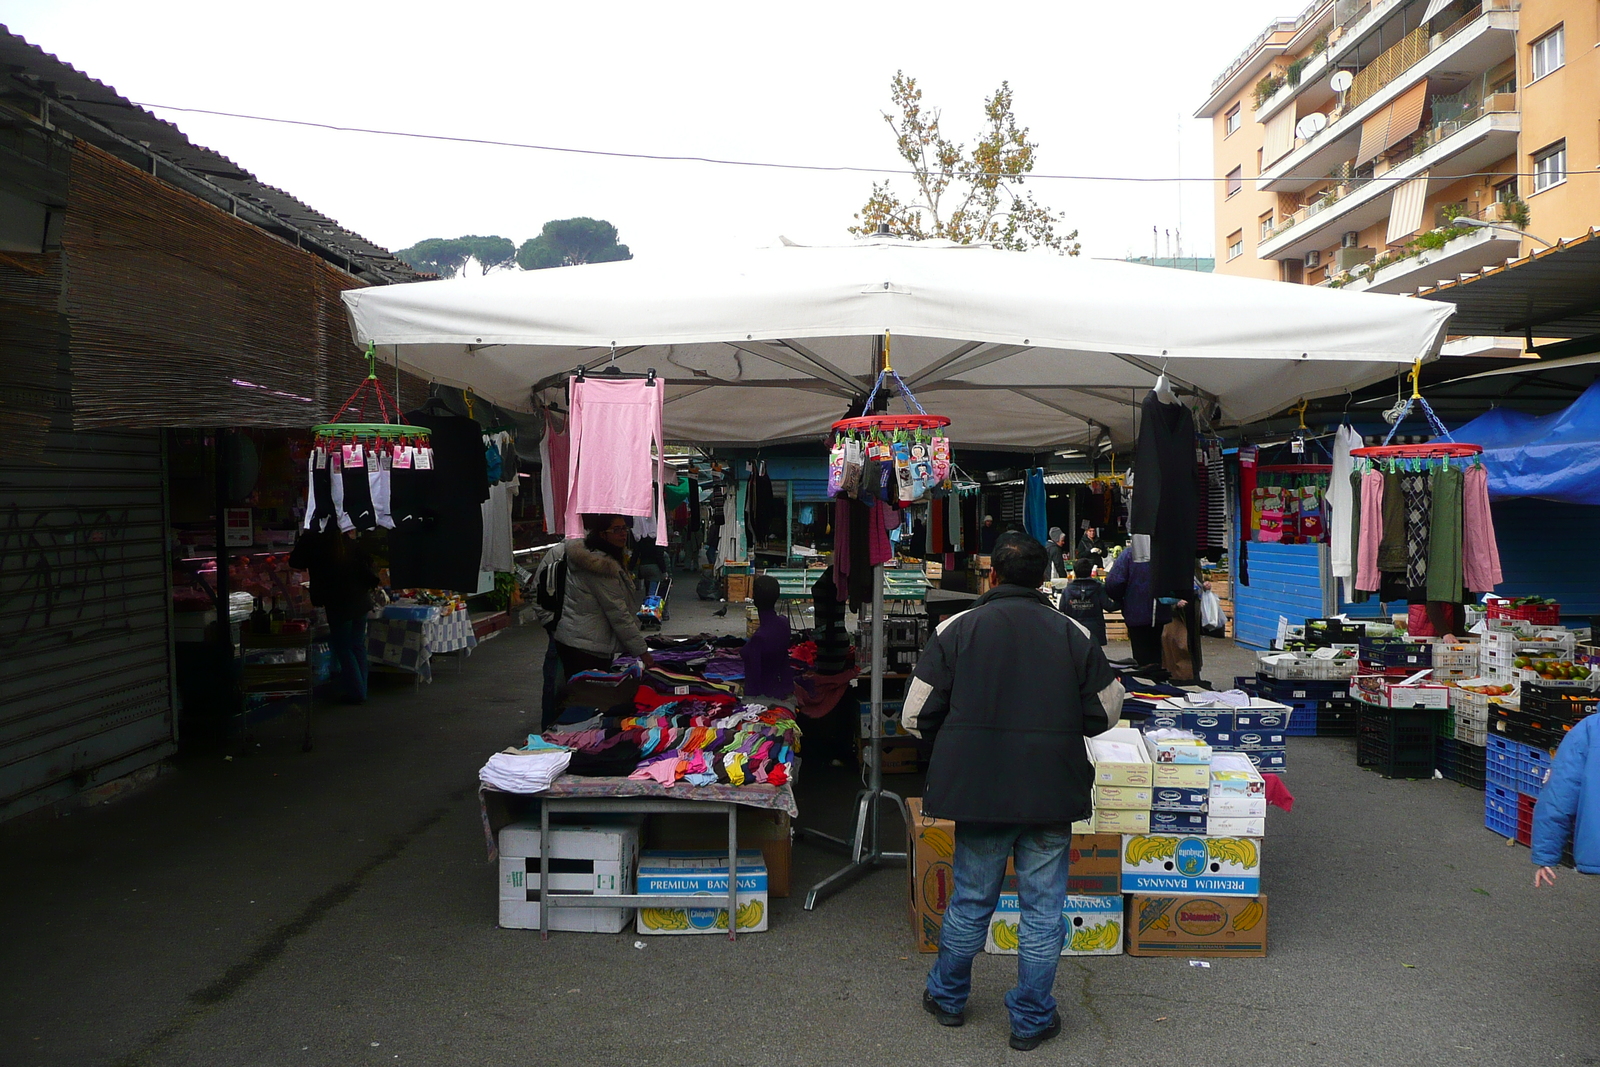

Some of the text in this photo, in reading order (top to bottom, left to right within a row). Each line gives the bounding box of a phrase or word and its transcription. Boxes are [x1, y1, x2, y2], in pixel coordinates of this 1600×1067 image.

[1179, 848, 1205, 858] Chiquita
[650, 879, 757, 890] PREMIUM BANNAS
[1067, 880, 1103, 889] PREMIU
[1137, 877, 1245, 890] PREMIUM BANANAS
[1063, 899, 1112, 909] BANANAS
[690, 909, 715, 919] Chiquita
